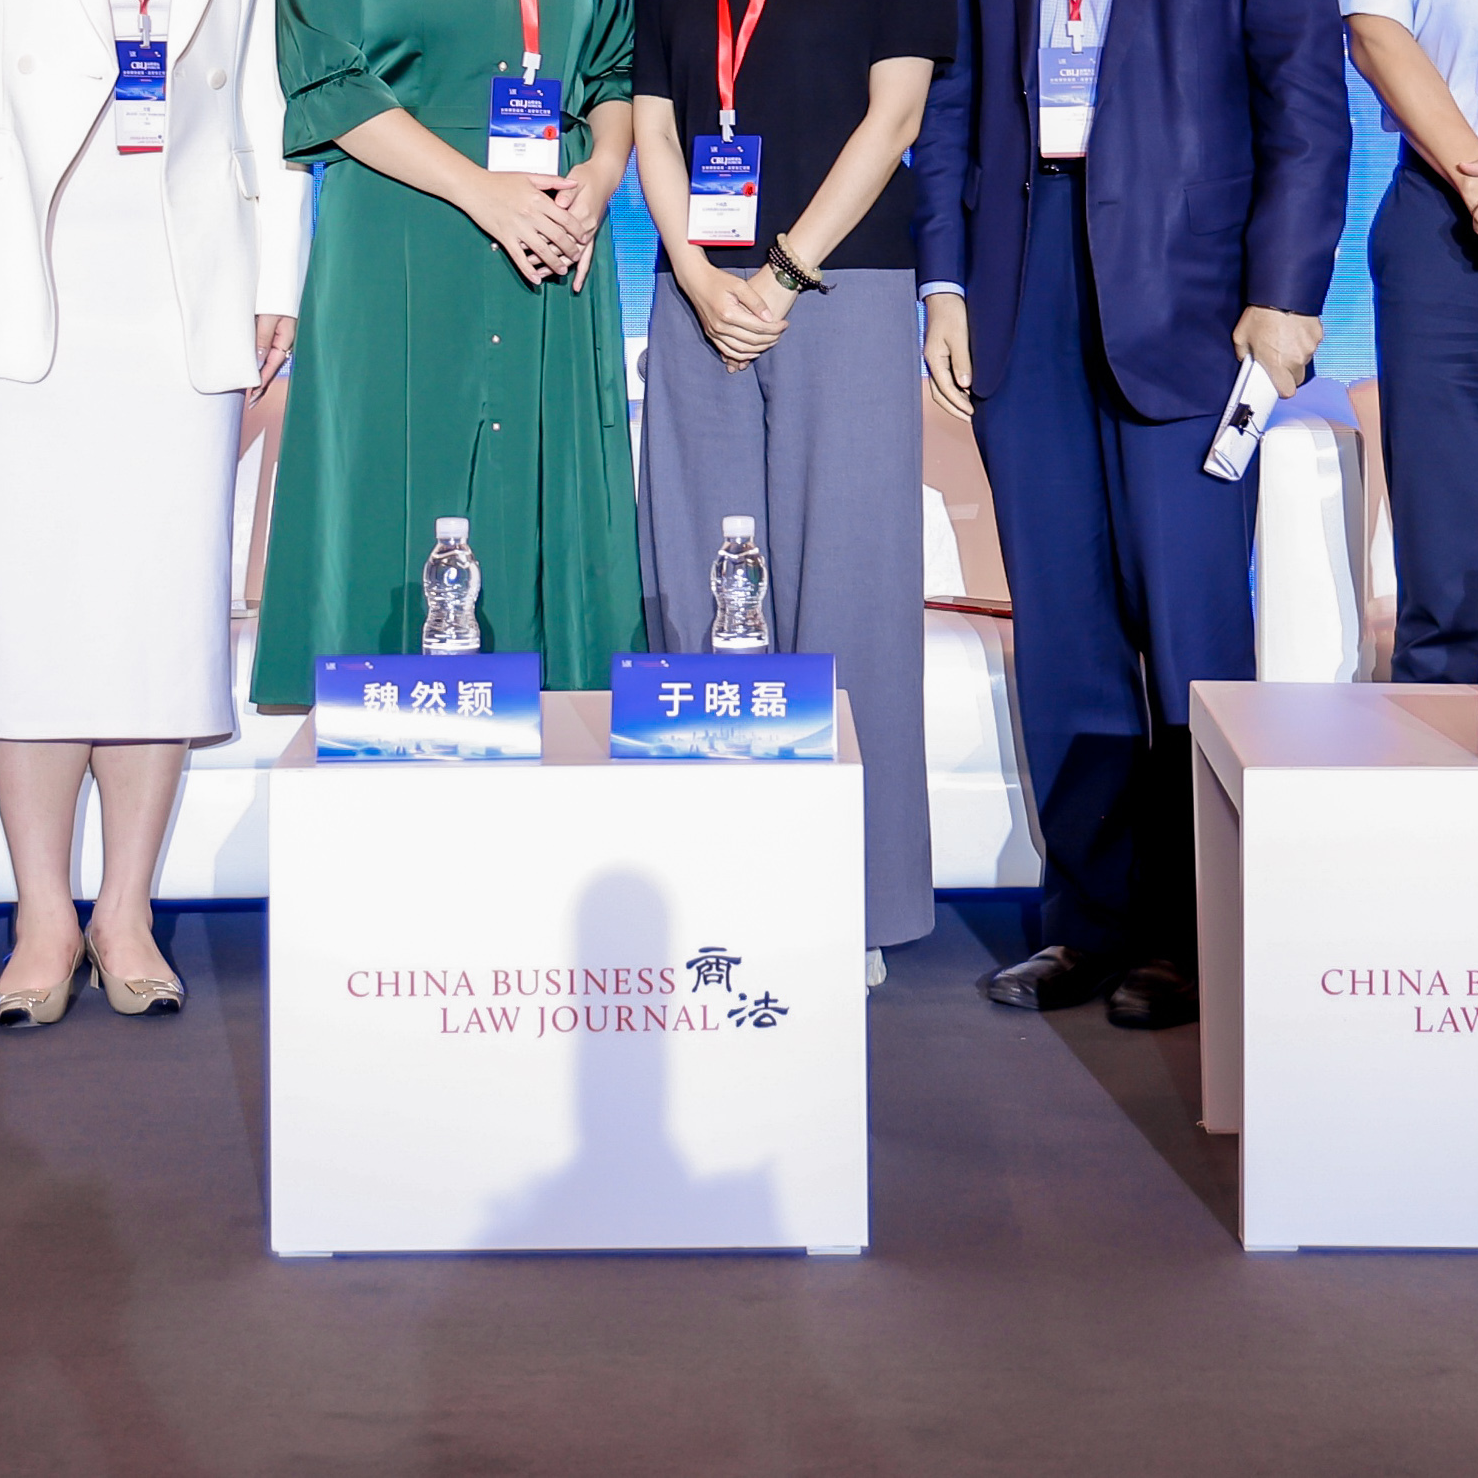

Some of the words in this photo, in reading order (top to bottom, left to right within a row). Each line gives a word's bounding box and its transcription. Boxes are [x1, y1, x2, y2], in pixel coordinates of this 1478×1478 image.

[363, 680, 494, 718] 魏然颖
[657, 680, 788, 718] 于晓磊
[347, 970, 476, 998] CHINA
[493, 967, 676, 996] BUSINESS
[1321, 969, 1450, 996] CHINA
[440, 1006, 520, 1034] LAW
[538, 1004, 719, 1038] JOURNAL
